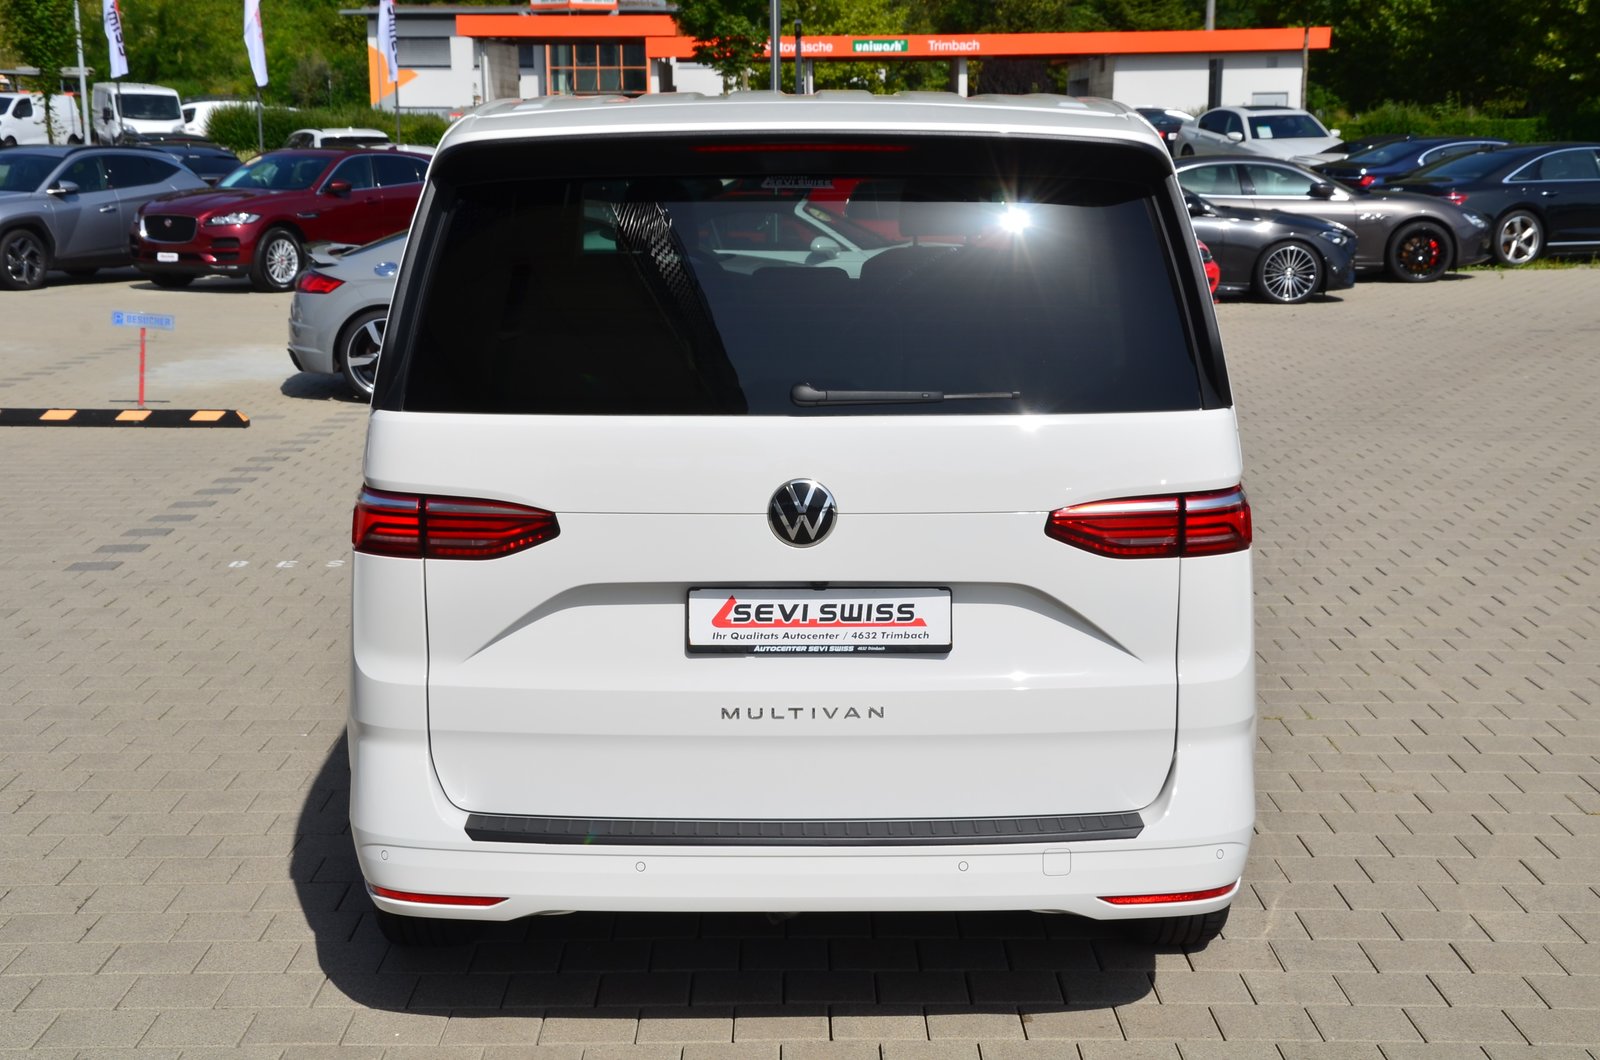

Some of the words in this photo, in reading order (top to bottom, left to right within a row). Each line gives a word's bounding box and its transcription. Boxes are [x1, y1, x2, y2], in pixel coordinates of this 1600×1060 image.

[766, 41, 833, 52] towäsche
[928, 40, 980, 51] Trimbach
[733, 603, 809, 622] SEVI
[819, 603, 915, 622] SWISS
[712, 632, 727, 640] Ihr
[730, 631, 779, 641] Qualitats
[782, 632, 840, 640] Autocenter
[851, 631, 877, 640] 4632
[881, 631, 930, 640] Trimbach
[721, 706, 884, 720] MULTIVAN
